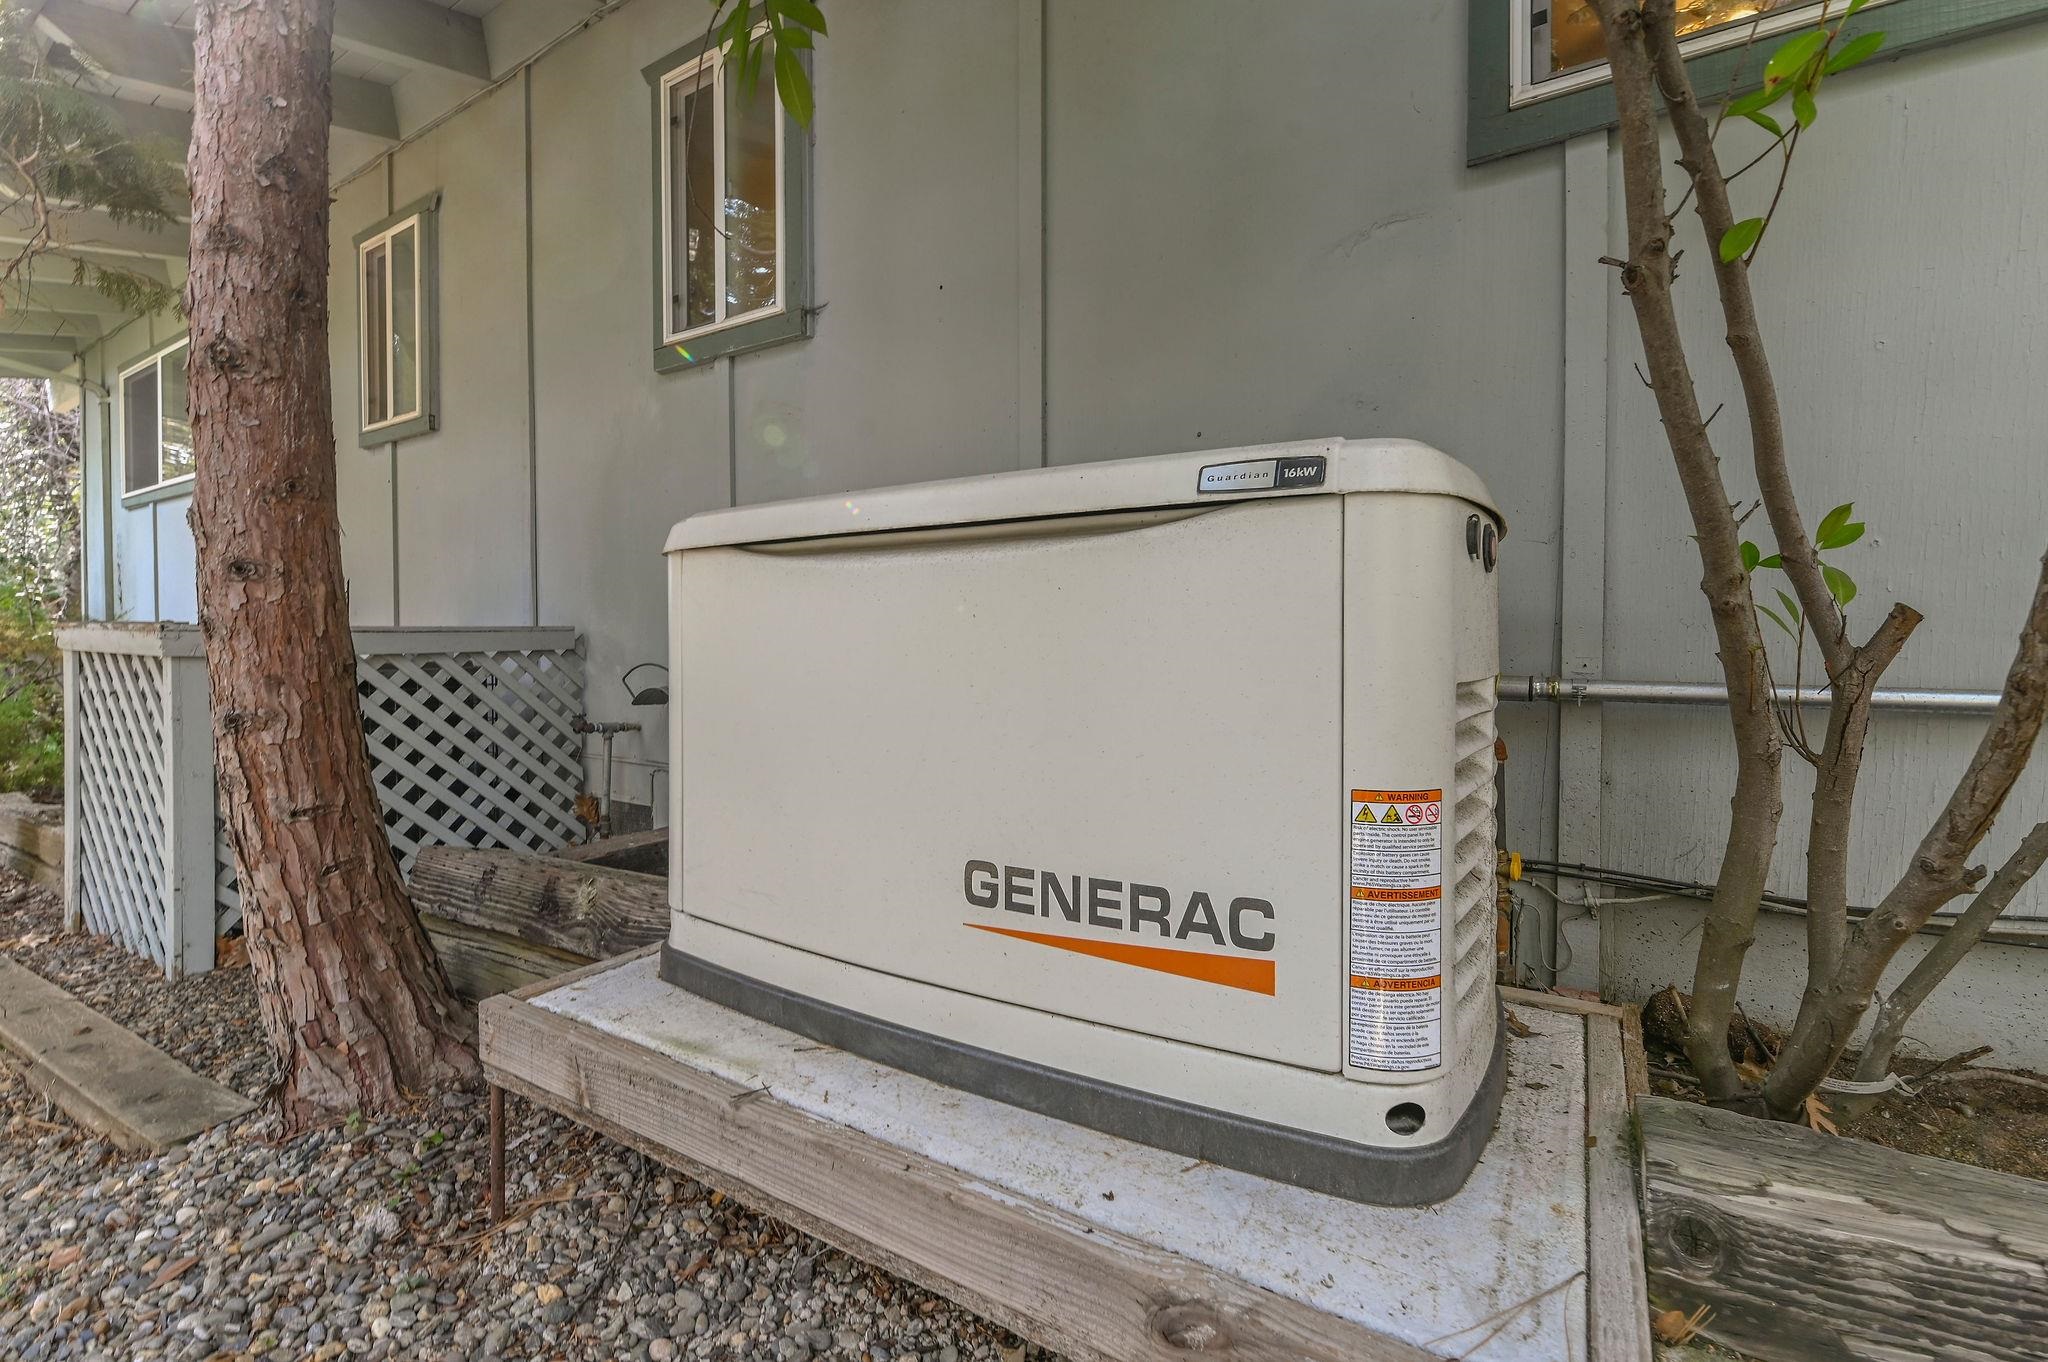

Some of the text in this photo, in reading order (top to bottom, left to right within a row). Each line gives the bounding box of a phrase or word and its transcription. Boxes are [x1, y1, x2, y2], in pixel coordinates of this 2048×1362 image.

[1207, 466, 1318, 482] Guardian 16kW
[1387, 792, 1429, 801] WARNING
[1368, 888, 1439, 900] AVERTISSEMENT
[964, 859, 1276, 952] GENERAC
